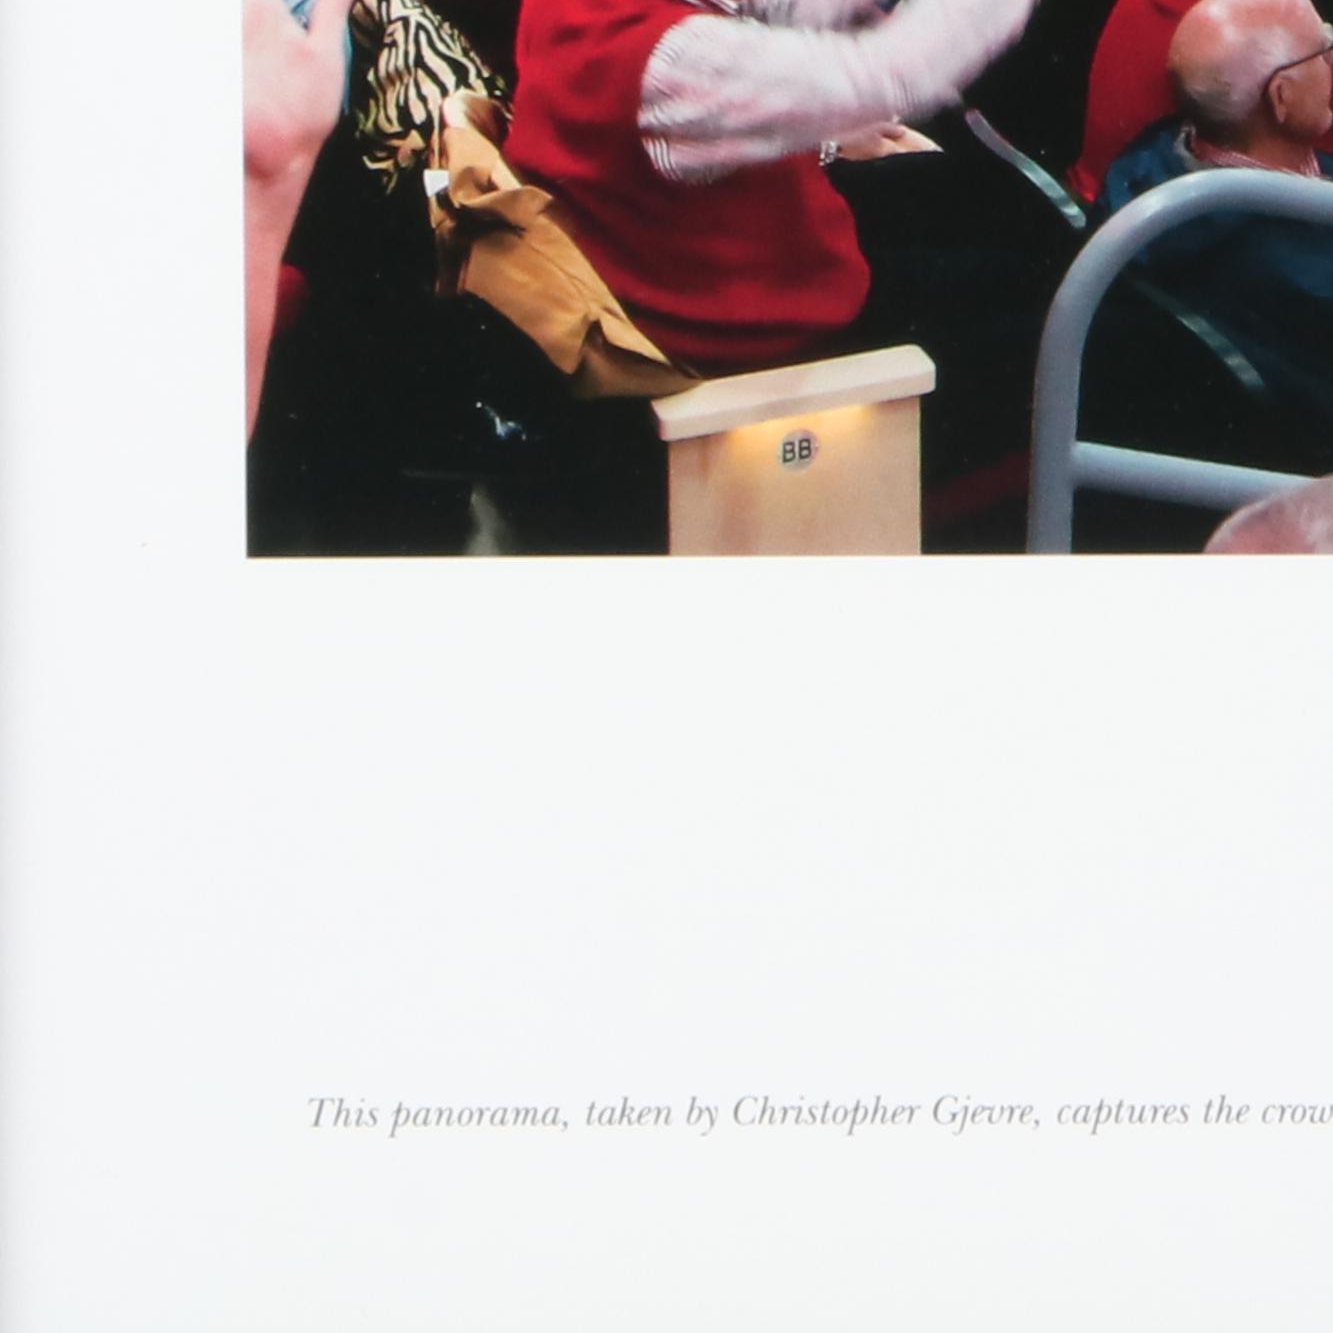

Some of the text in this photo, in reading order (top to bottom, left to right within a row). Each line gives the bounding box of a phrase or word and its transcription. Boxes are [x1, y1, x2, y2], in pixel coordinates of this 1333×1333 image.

[782, 437, 813, 464] BB
[308, 1097, 378, 1128] This
[389, 1101, 569, 1139] panorama,
[585, 1096, 672, 1126] taken
[685, 1095, 719, 1137] by
[732, 1095, 921, 1137] Christopher
[932, 1095, 1040, 1135] Gjevre,
[1056, 1098, 1190, 1136] captures
[1203, 1094, 1251, 1124] the
